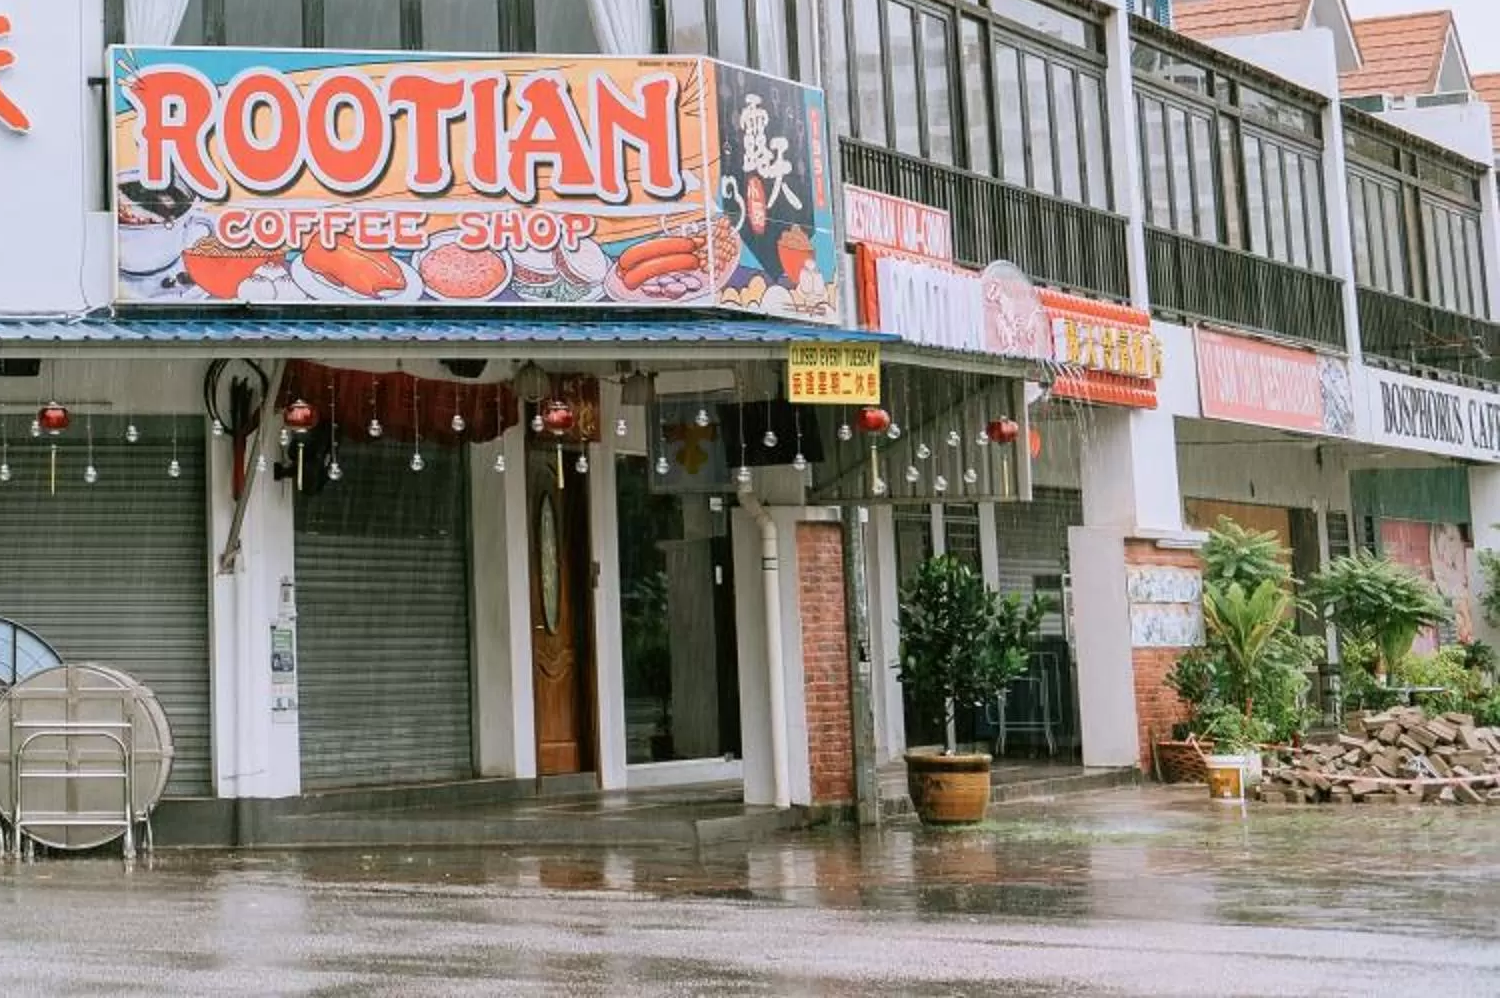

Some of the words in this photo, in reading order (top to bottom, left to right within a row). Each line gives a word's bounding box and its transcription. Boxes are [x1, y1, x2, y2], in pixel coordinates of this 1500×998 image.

[138, 70, 683, 202] ROOTIAN
[216, 209, 427, 249] COFFEE
[455, 210, 596, 252] SHOP
[792, 347, 817, 366] CLOSED
[843, 347, 876, 367] TUESDAY
[1381, 381, 1464, 444] BOSPHORUS
